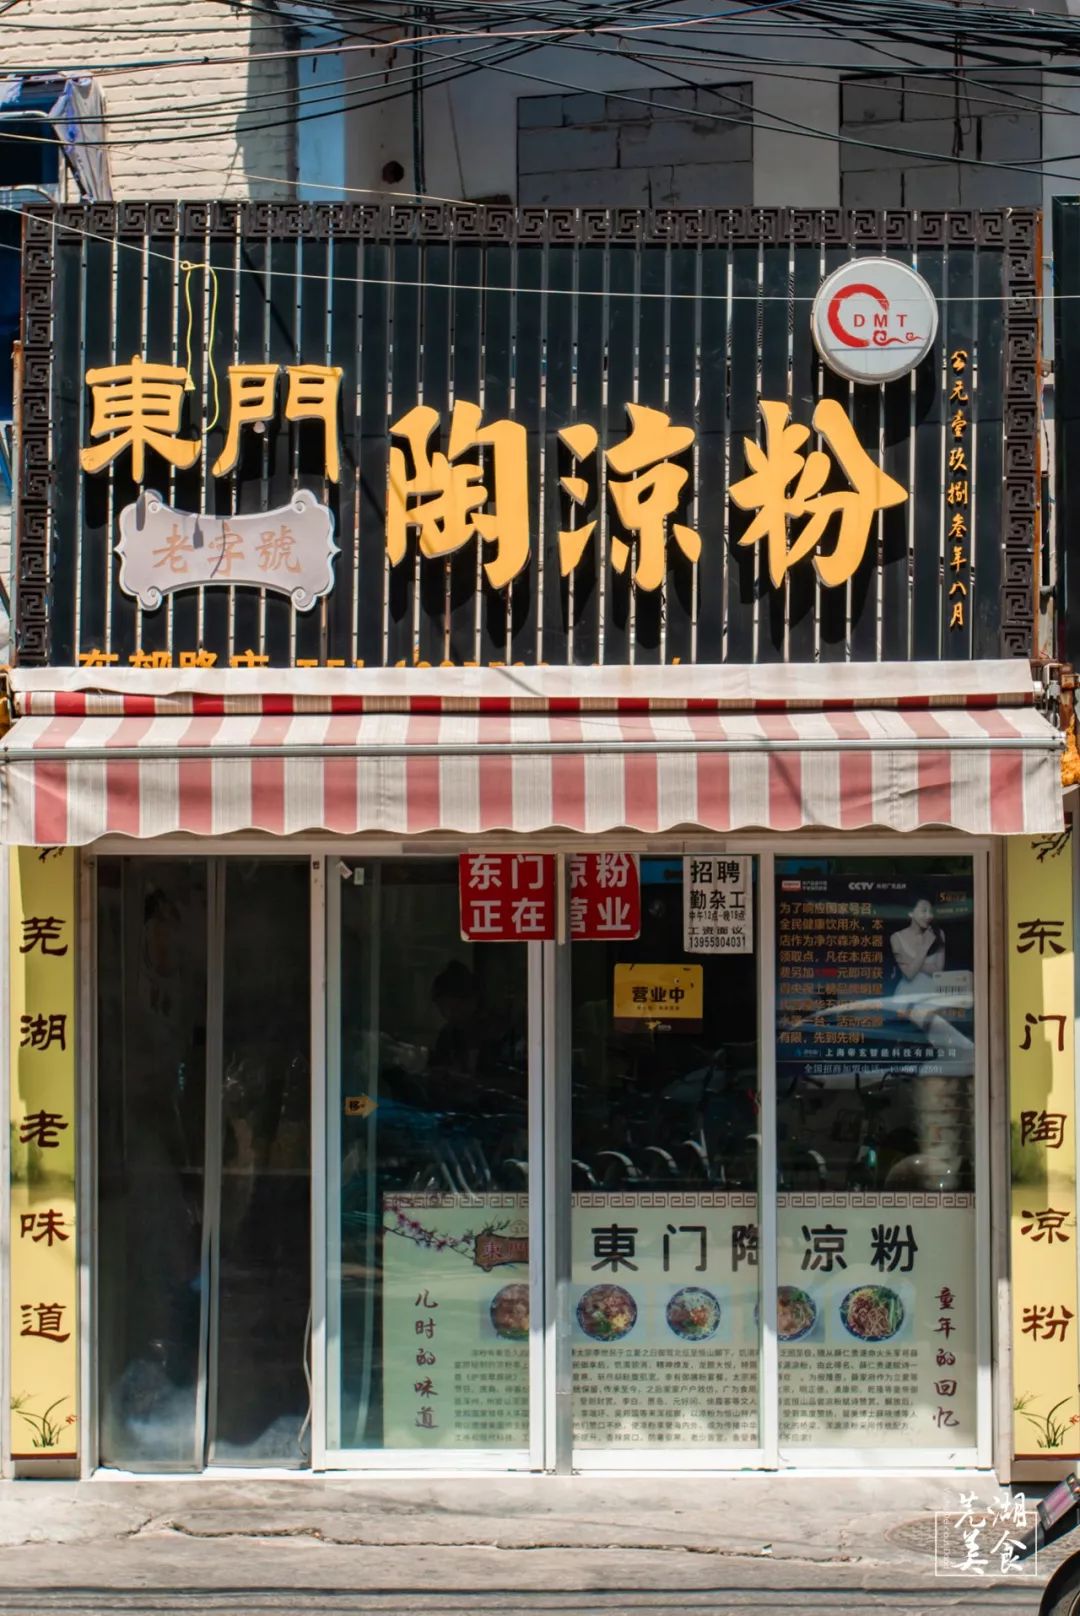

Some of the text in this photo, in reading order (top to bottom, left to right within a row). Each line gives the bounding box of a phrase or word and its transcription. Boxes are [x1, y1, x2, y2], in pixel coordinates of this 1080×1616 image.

[853, 313, 908, 328] DMT
[80, 354, 343, 484] 東門
[152, 523, 303, 574] 老字號
[690, 860, 740, 884] 招聘
[848, 882, 874, 890] CCTV
[689, 889, 745, 910] 勤杂工
[632, 987, 685, 1003] 营业中
[19, 917, 71, 1342] 芜湖老味道
[1017, 919, 1074, 1342] 东门陶凉粉
[414, 1289, 439, 1429] 儿时的味道
[932, 1286, 960, 1429] 童年的回忆
